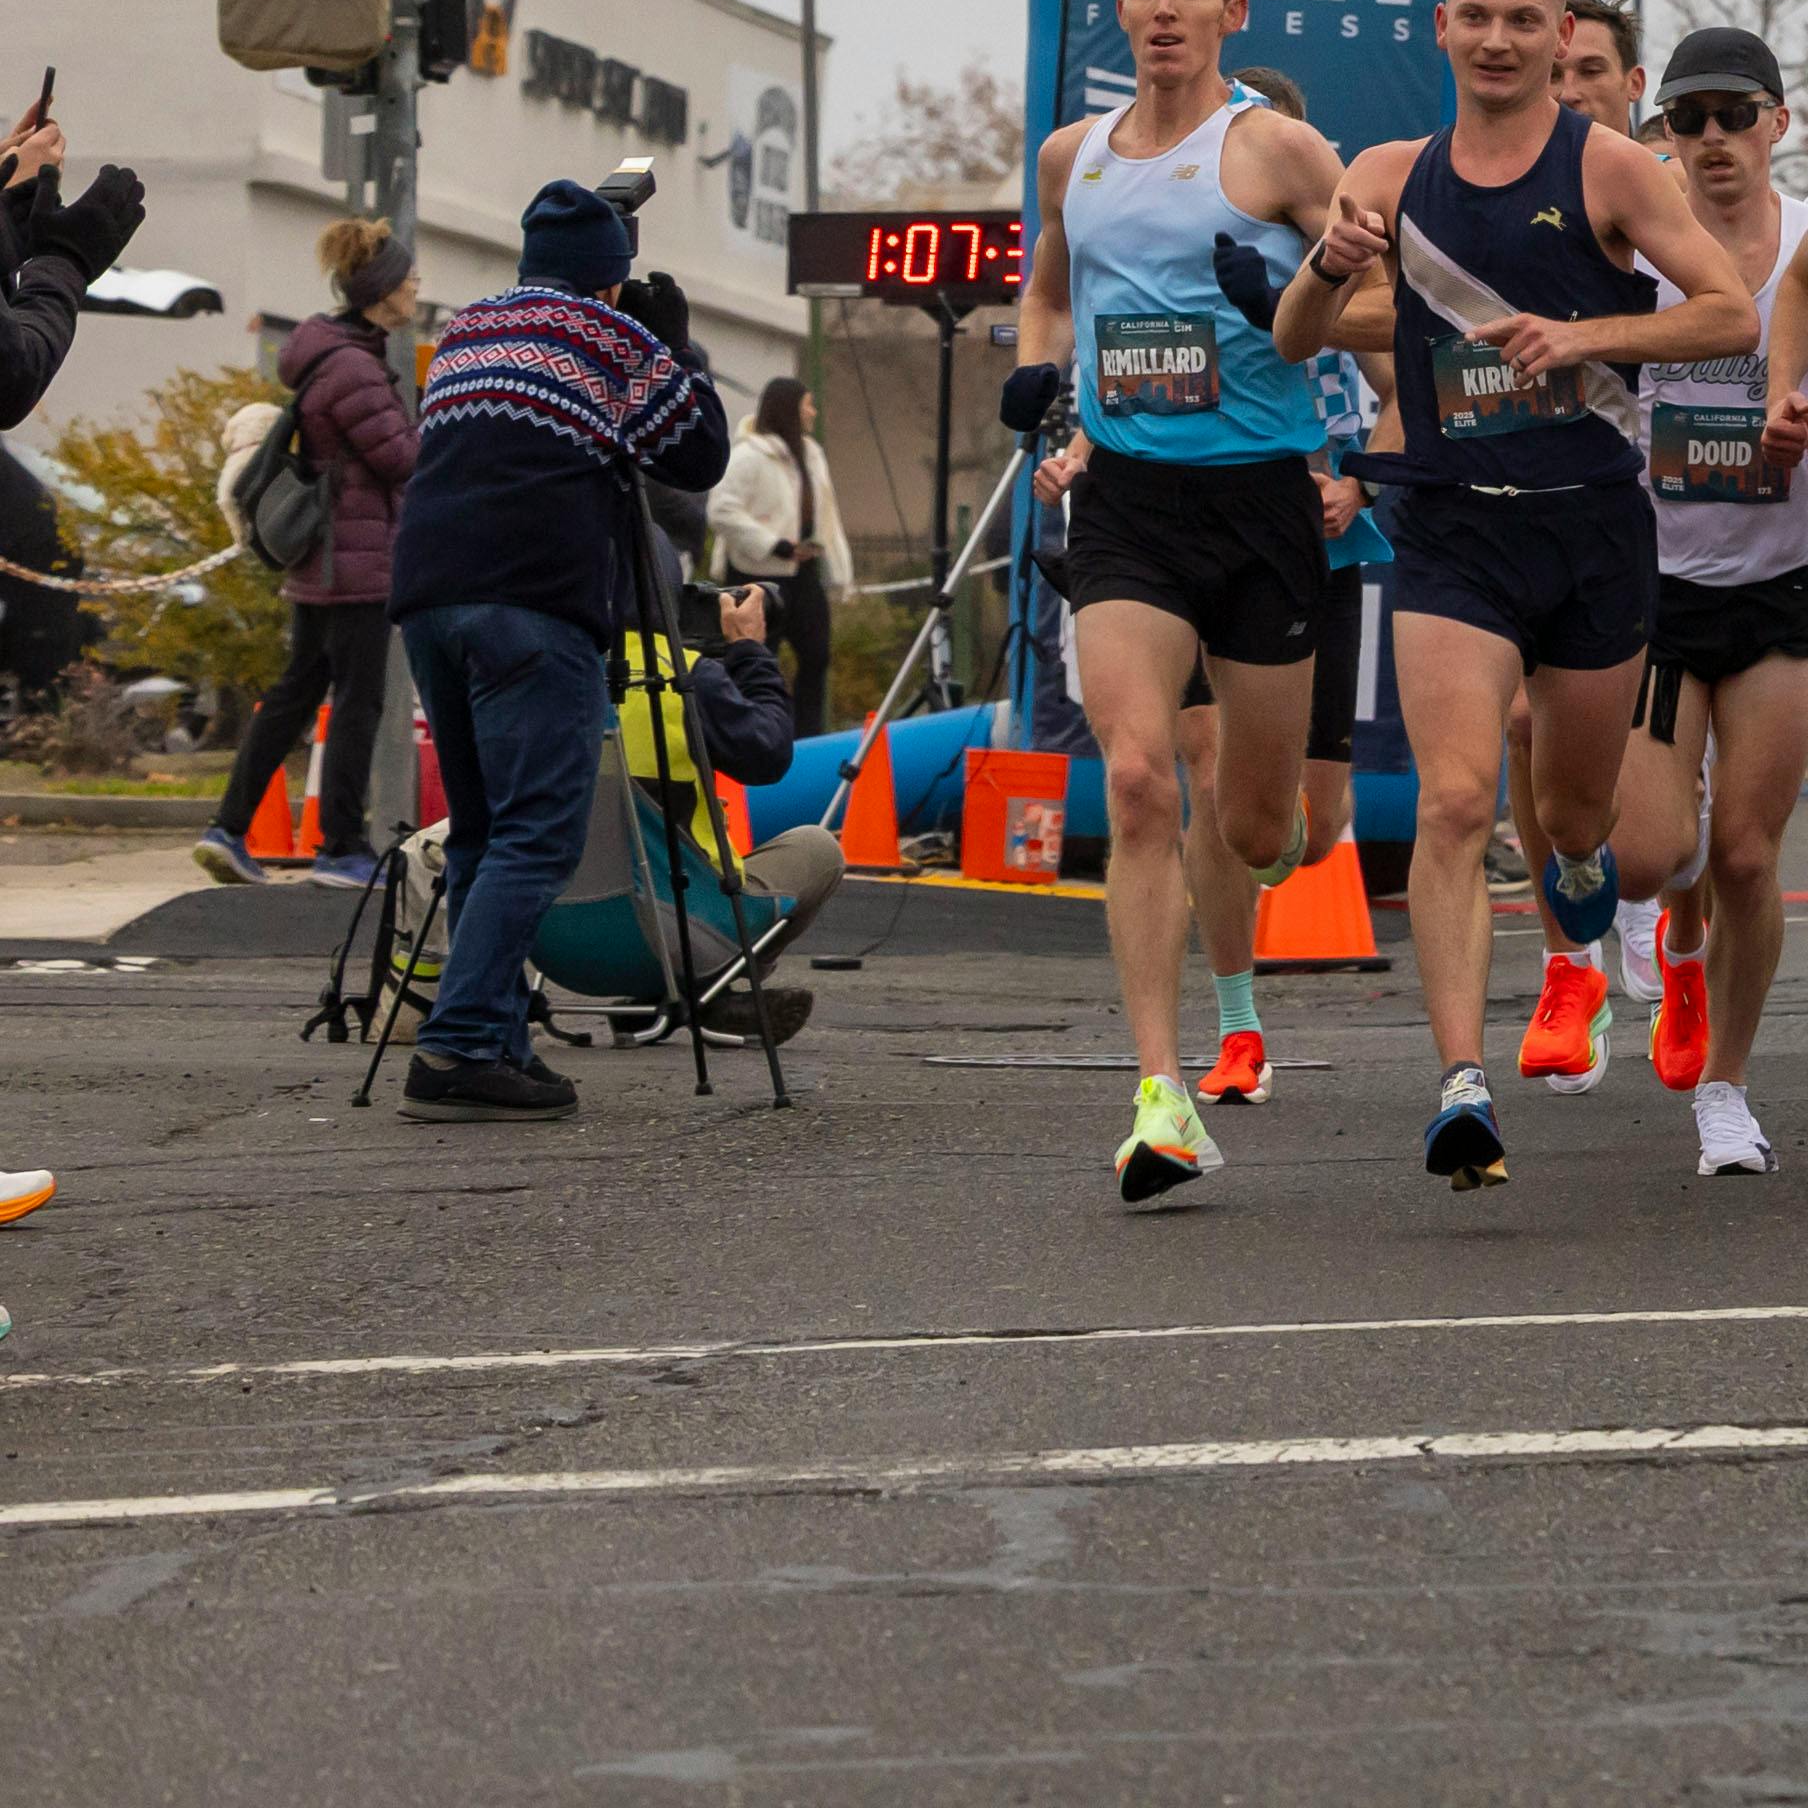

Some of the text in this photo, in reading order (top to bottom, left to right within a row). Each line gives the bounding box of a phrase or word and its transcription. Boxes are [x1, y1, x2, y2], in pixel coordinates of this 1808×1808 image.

[1120, 320, 1170, 330] CALIFORNIA
[1174, 324, 1192, 333] CIM
[1462, 364, 1548, 397] KIRKV
[1554, 406, 1565, 415] 91
[1454, 418, 1477, 428] ELITE
[1693, 413, 1747, 423] CALIFORNIA
[1687, 440, 1752, 467] DOUD
